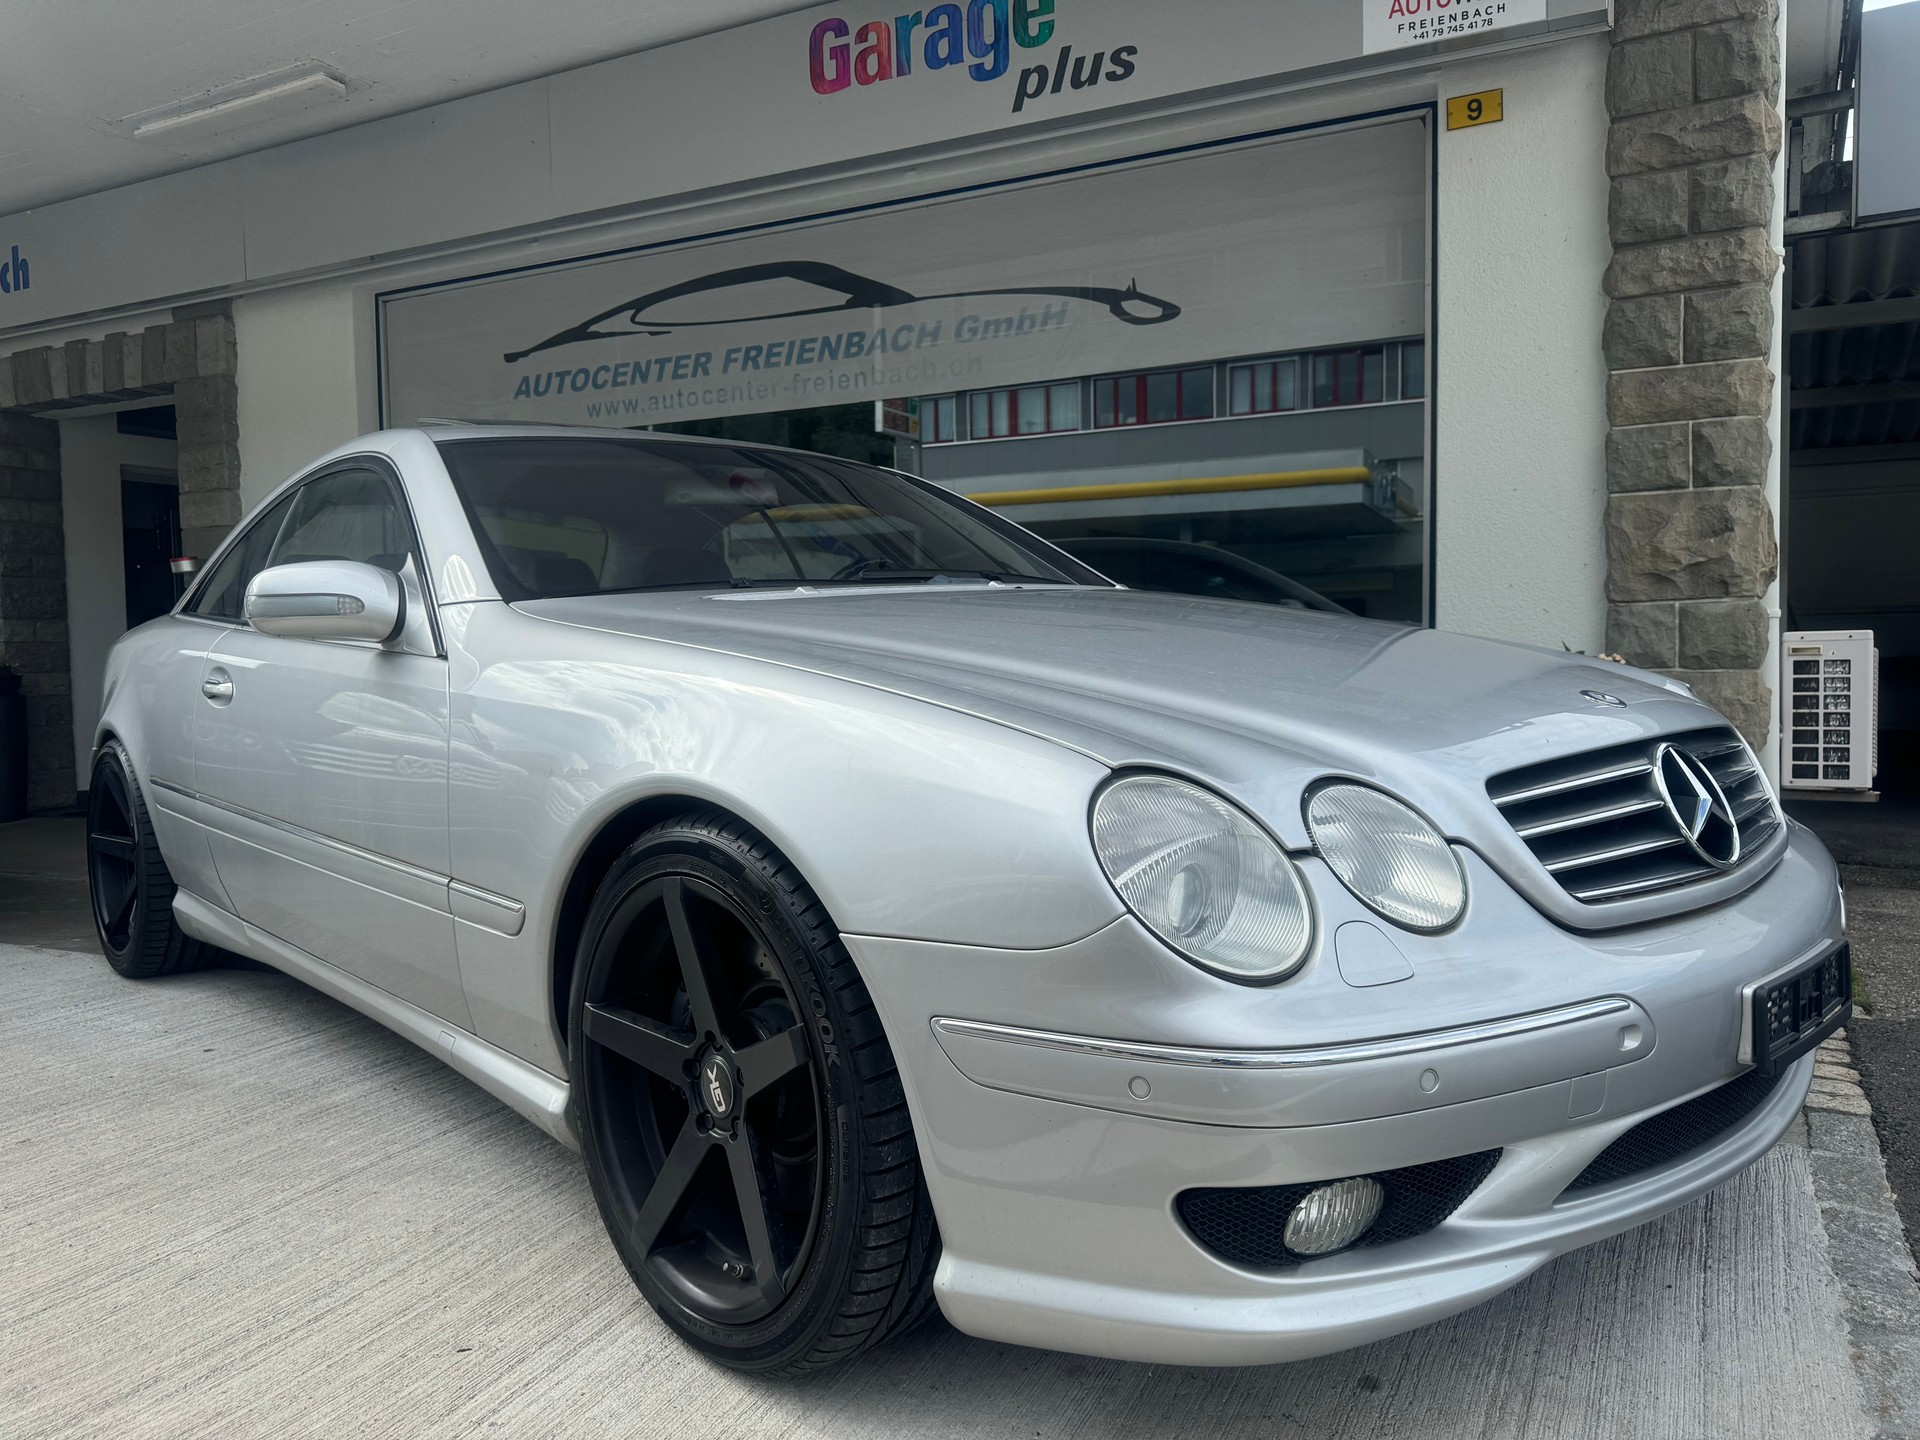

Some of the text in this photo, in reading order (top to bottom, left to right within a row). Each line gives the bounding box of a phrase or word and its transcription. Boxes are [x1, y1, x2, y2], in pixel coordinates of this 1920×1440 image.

[808, 0, 1056, 95] Garage
[1397, 3, 1506, 34] FREIENBACH
[1412, 18, 1493, 40] +41 79 745 41 78
[1011, 45, 1138, 113] plus
[1467, 98, 1483, 121] 9
[513, 301, 1069, 400] AUTOCENTER FREIENBACH GmbH
[586, 353, 983, 419] www.autocenter-freienbach.ch
